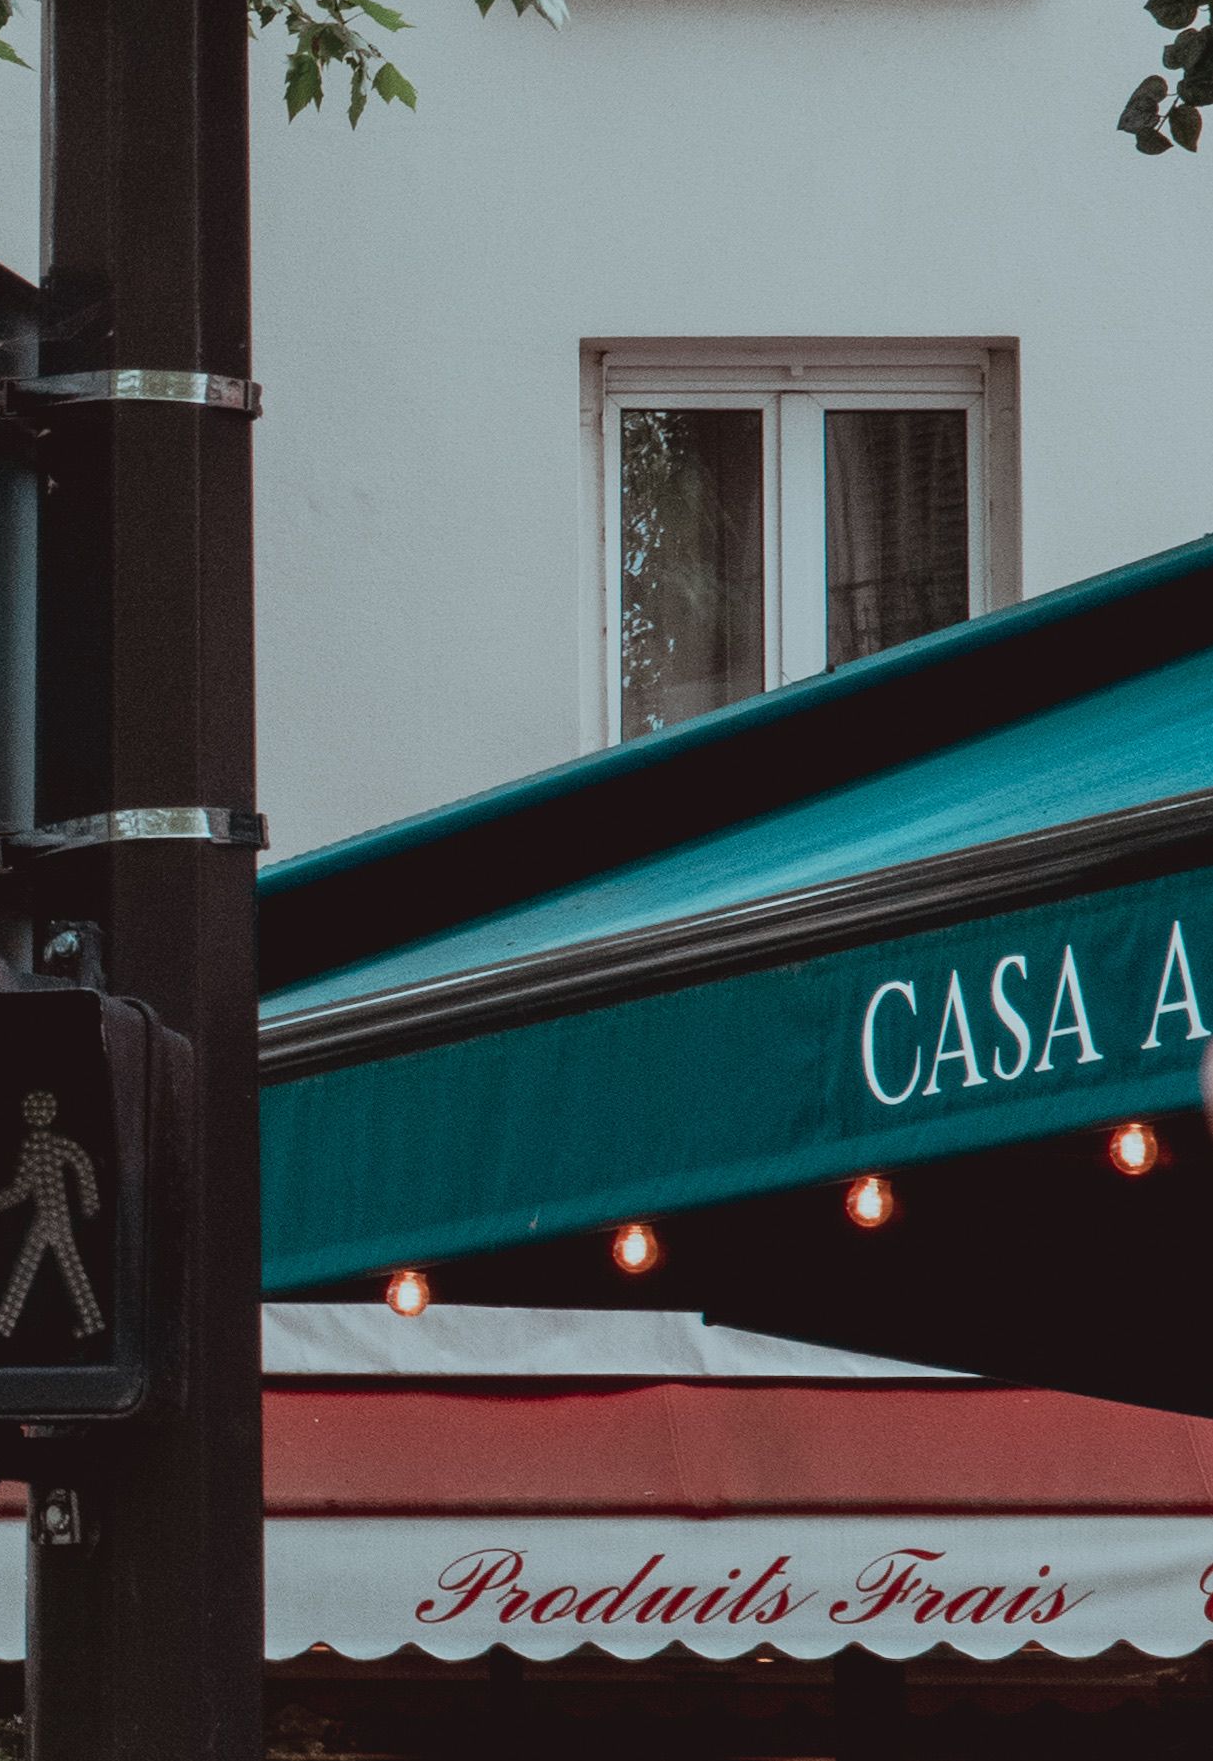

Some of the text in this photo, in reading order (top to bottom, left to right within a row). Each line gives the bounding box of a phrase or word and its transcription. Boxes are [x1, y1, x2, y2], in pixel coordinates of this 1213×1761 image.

[861, 944, 1103, 1106] CASA
[415, 1547, 1095, 1625] Produits Frais
